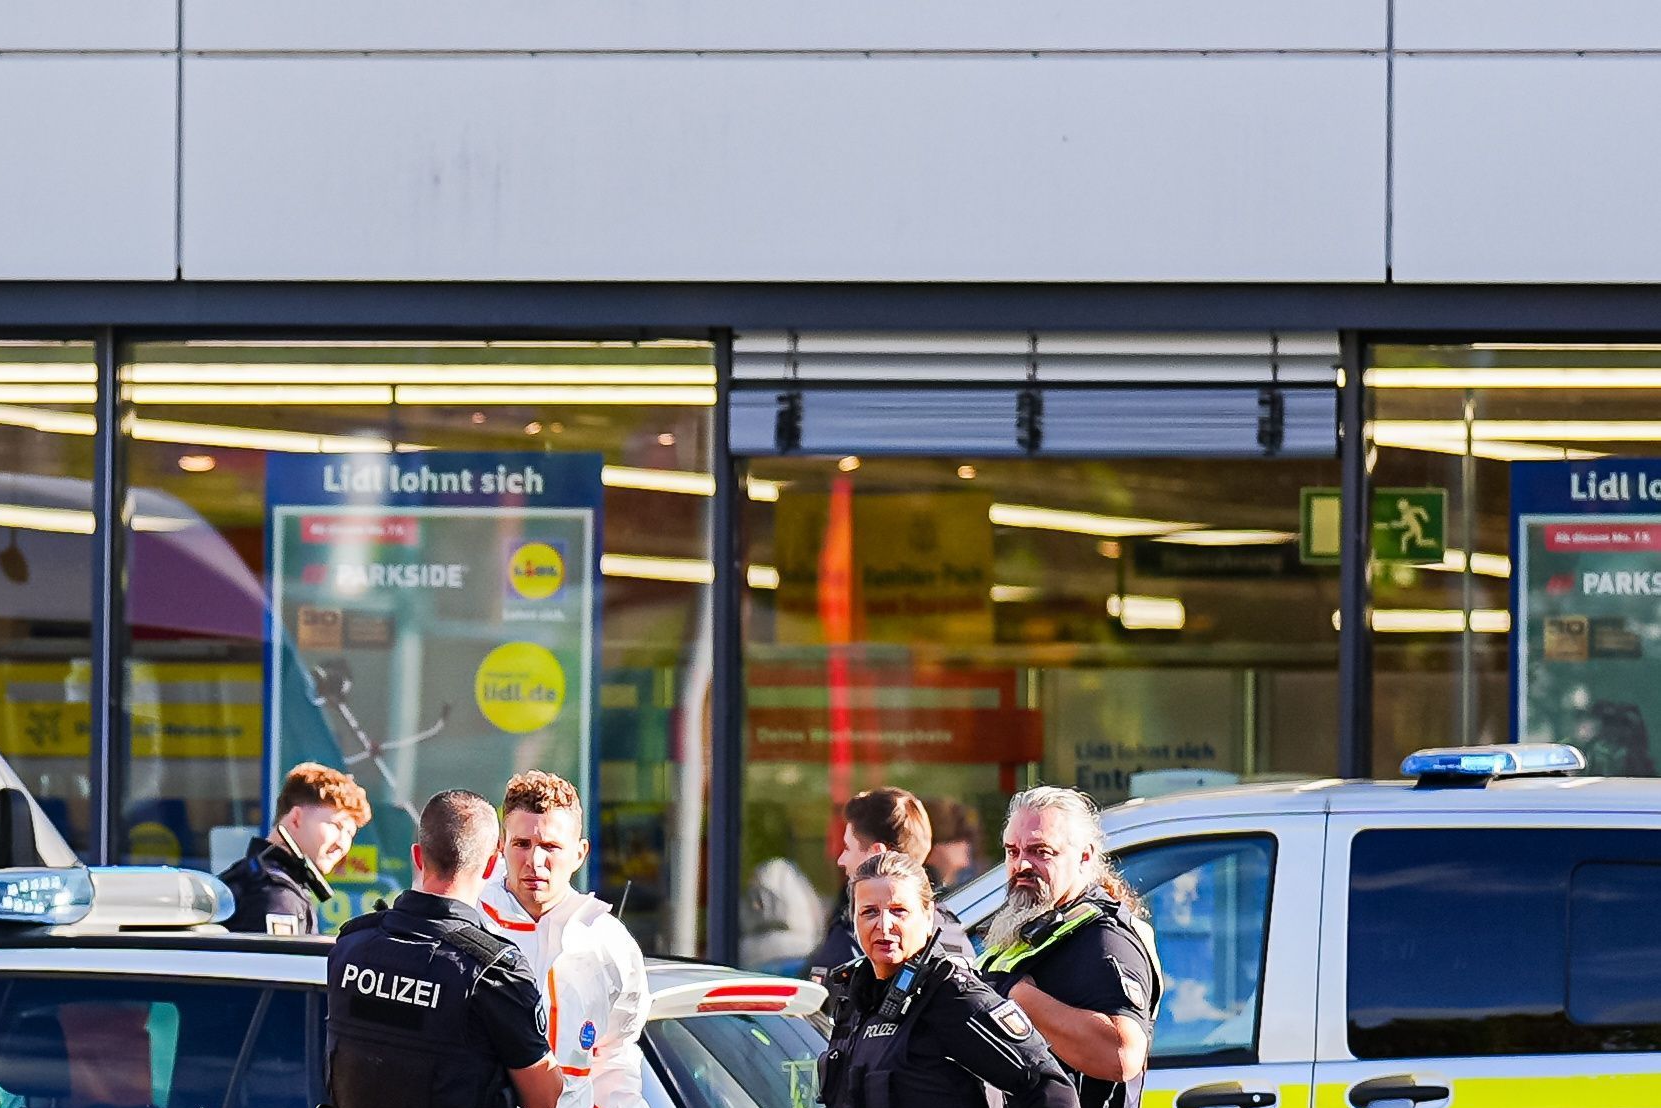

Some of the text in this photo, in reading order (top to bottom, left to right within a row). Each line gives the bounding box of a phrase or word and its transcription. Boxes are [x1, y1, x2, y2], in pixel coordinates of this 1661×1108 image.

[323, 464, 544, 494] Lidl lohnt sich
[1571, 470, 1630, 500] Lidl
[337, 563, 464, 589] PARKSIDE
[341, 963, 441, 1009] POLIZEI
